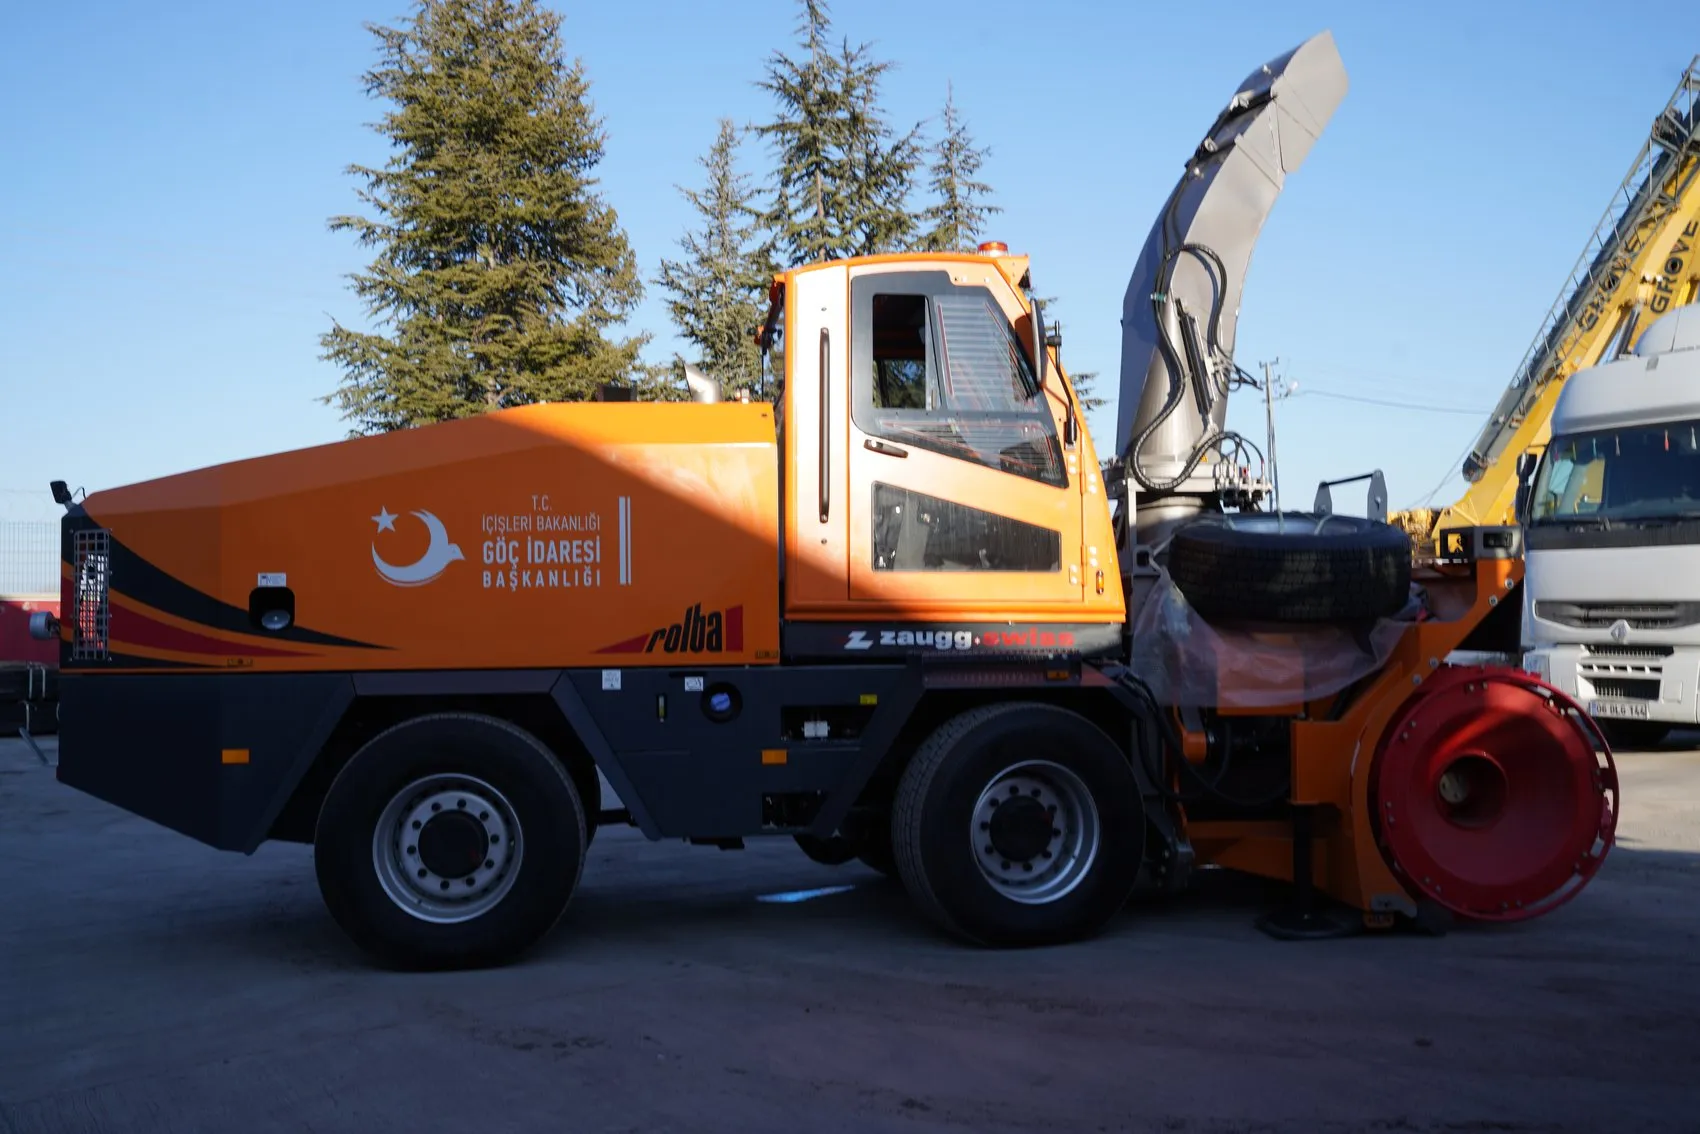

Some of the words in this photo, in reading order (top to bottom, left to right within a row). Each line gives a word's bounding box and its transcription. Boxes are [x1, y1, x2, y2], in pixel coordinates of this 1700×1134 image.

[1650, 220, 1699, 314] GROVE
[532, 494, 552, 511] T.C.
[482, 513, 532, 536] İÇİŞLERİ
[536, 511, 600, 532] BAKANLIĞI
[483, 535, 520, 570] GÖÇ
[527, 535, 601, 565] İDARESİ
[482, 565, 601, 592] BAŞKANLIĞI
[644, 601, 723, 654] rolba
